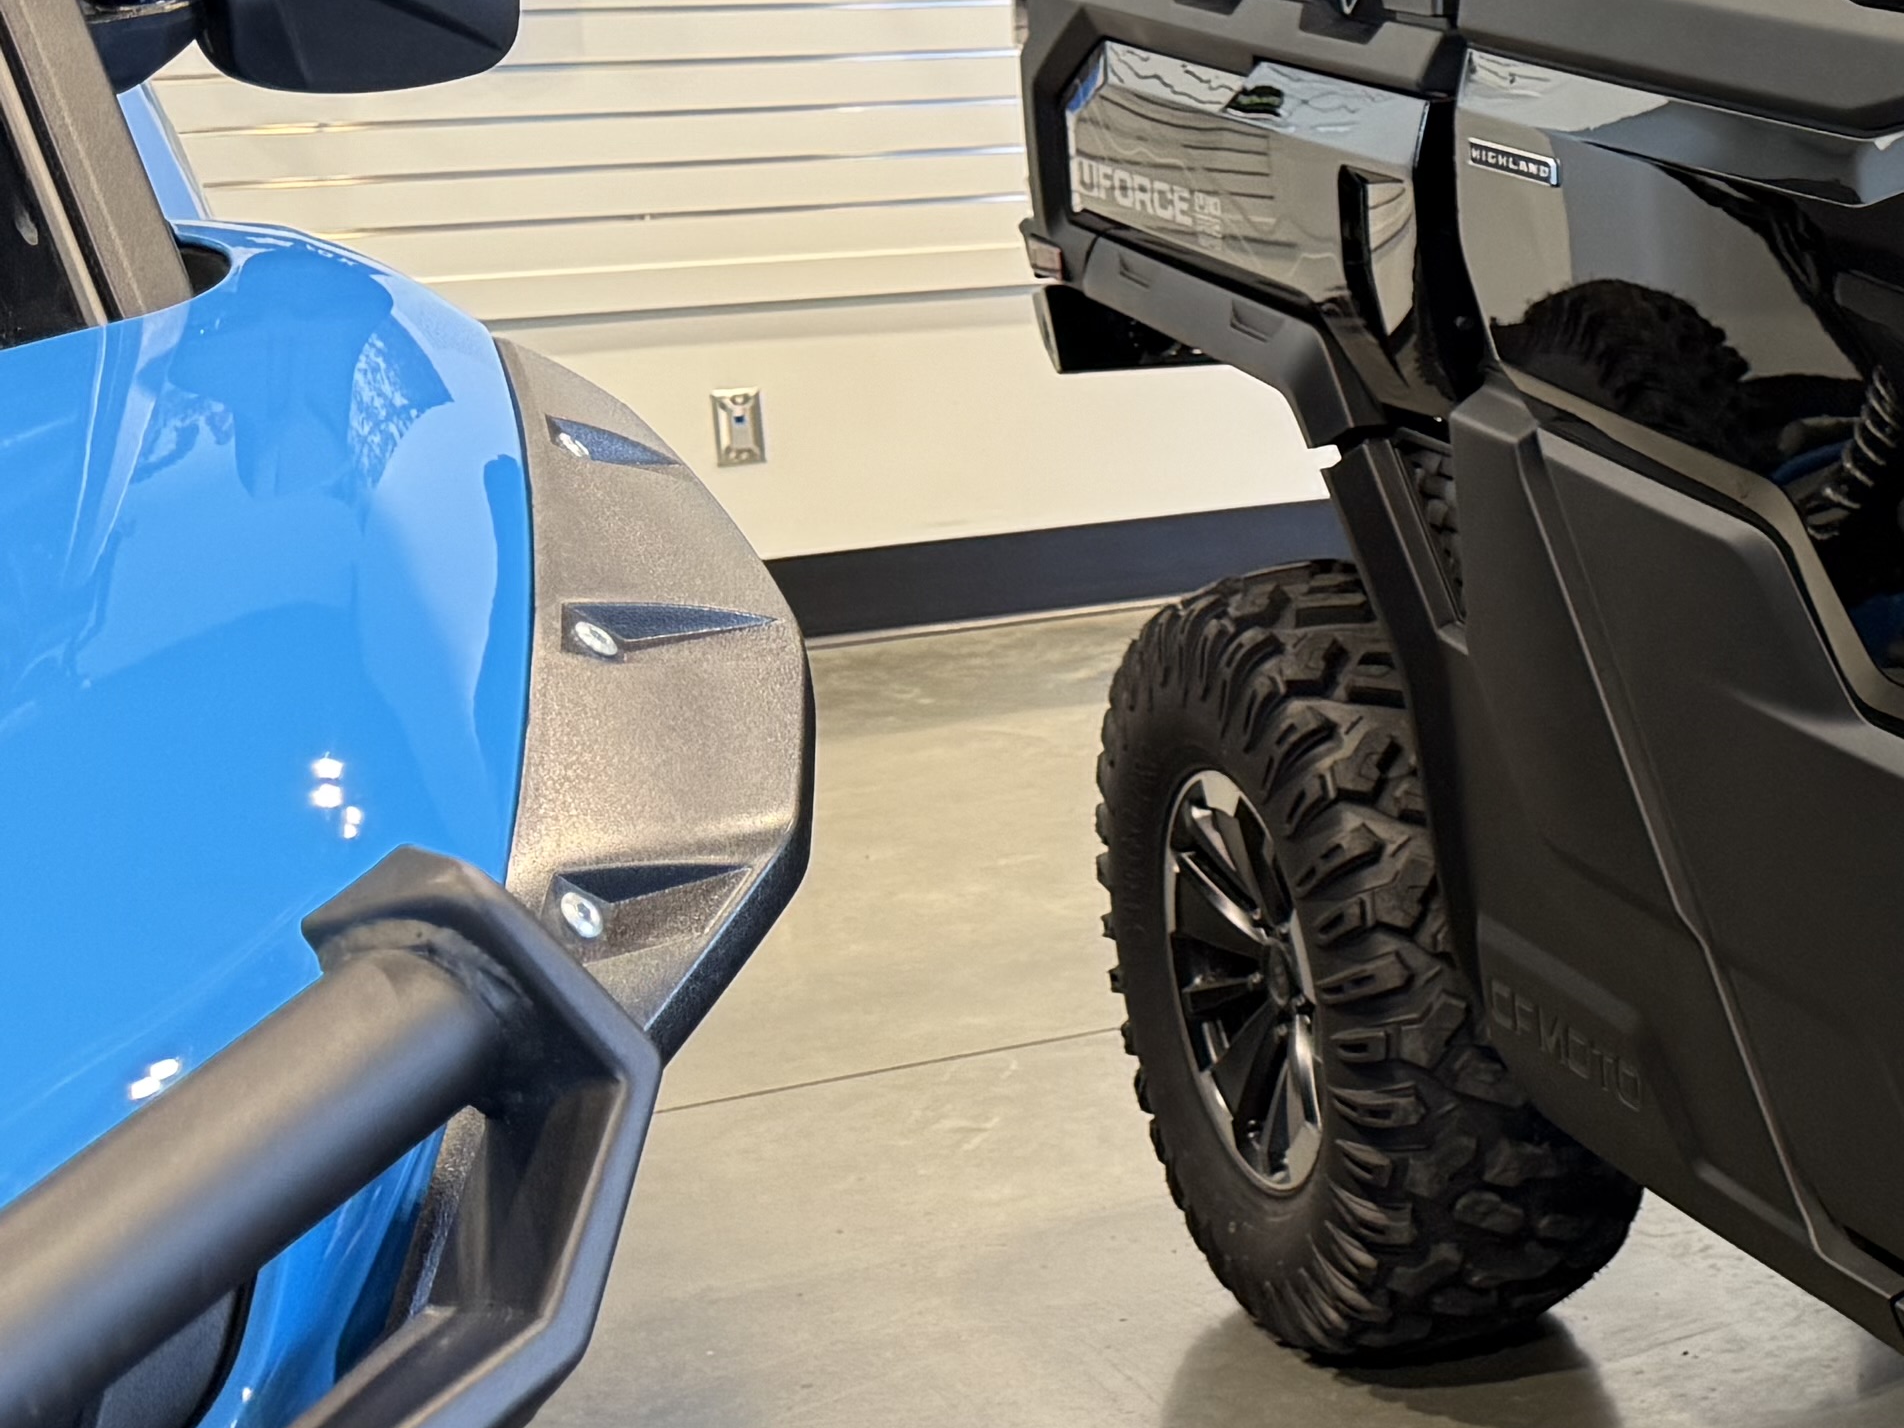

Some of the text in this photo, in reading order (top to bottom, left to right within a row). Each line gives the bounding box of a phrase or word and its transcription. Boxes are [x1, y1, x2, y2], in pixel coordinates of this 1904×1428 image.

[1076, 158, 1193, 228] UFORCE
[1471, 147, 1549, 178] HIGHLAND
[1486, 976, 1643, 1113] CFMOTO
